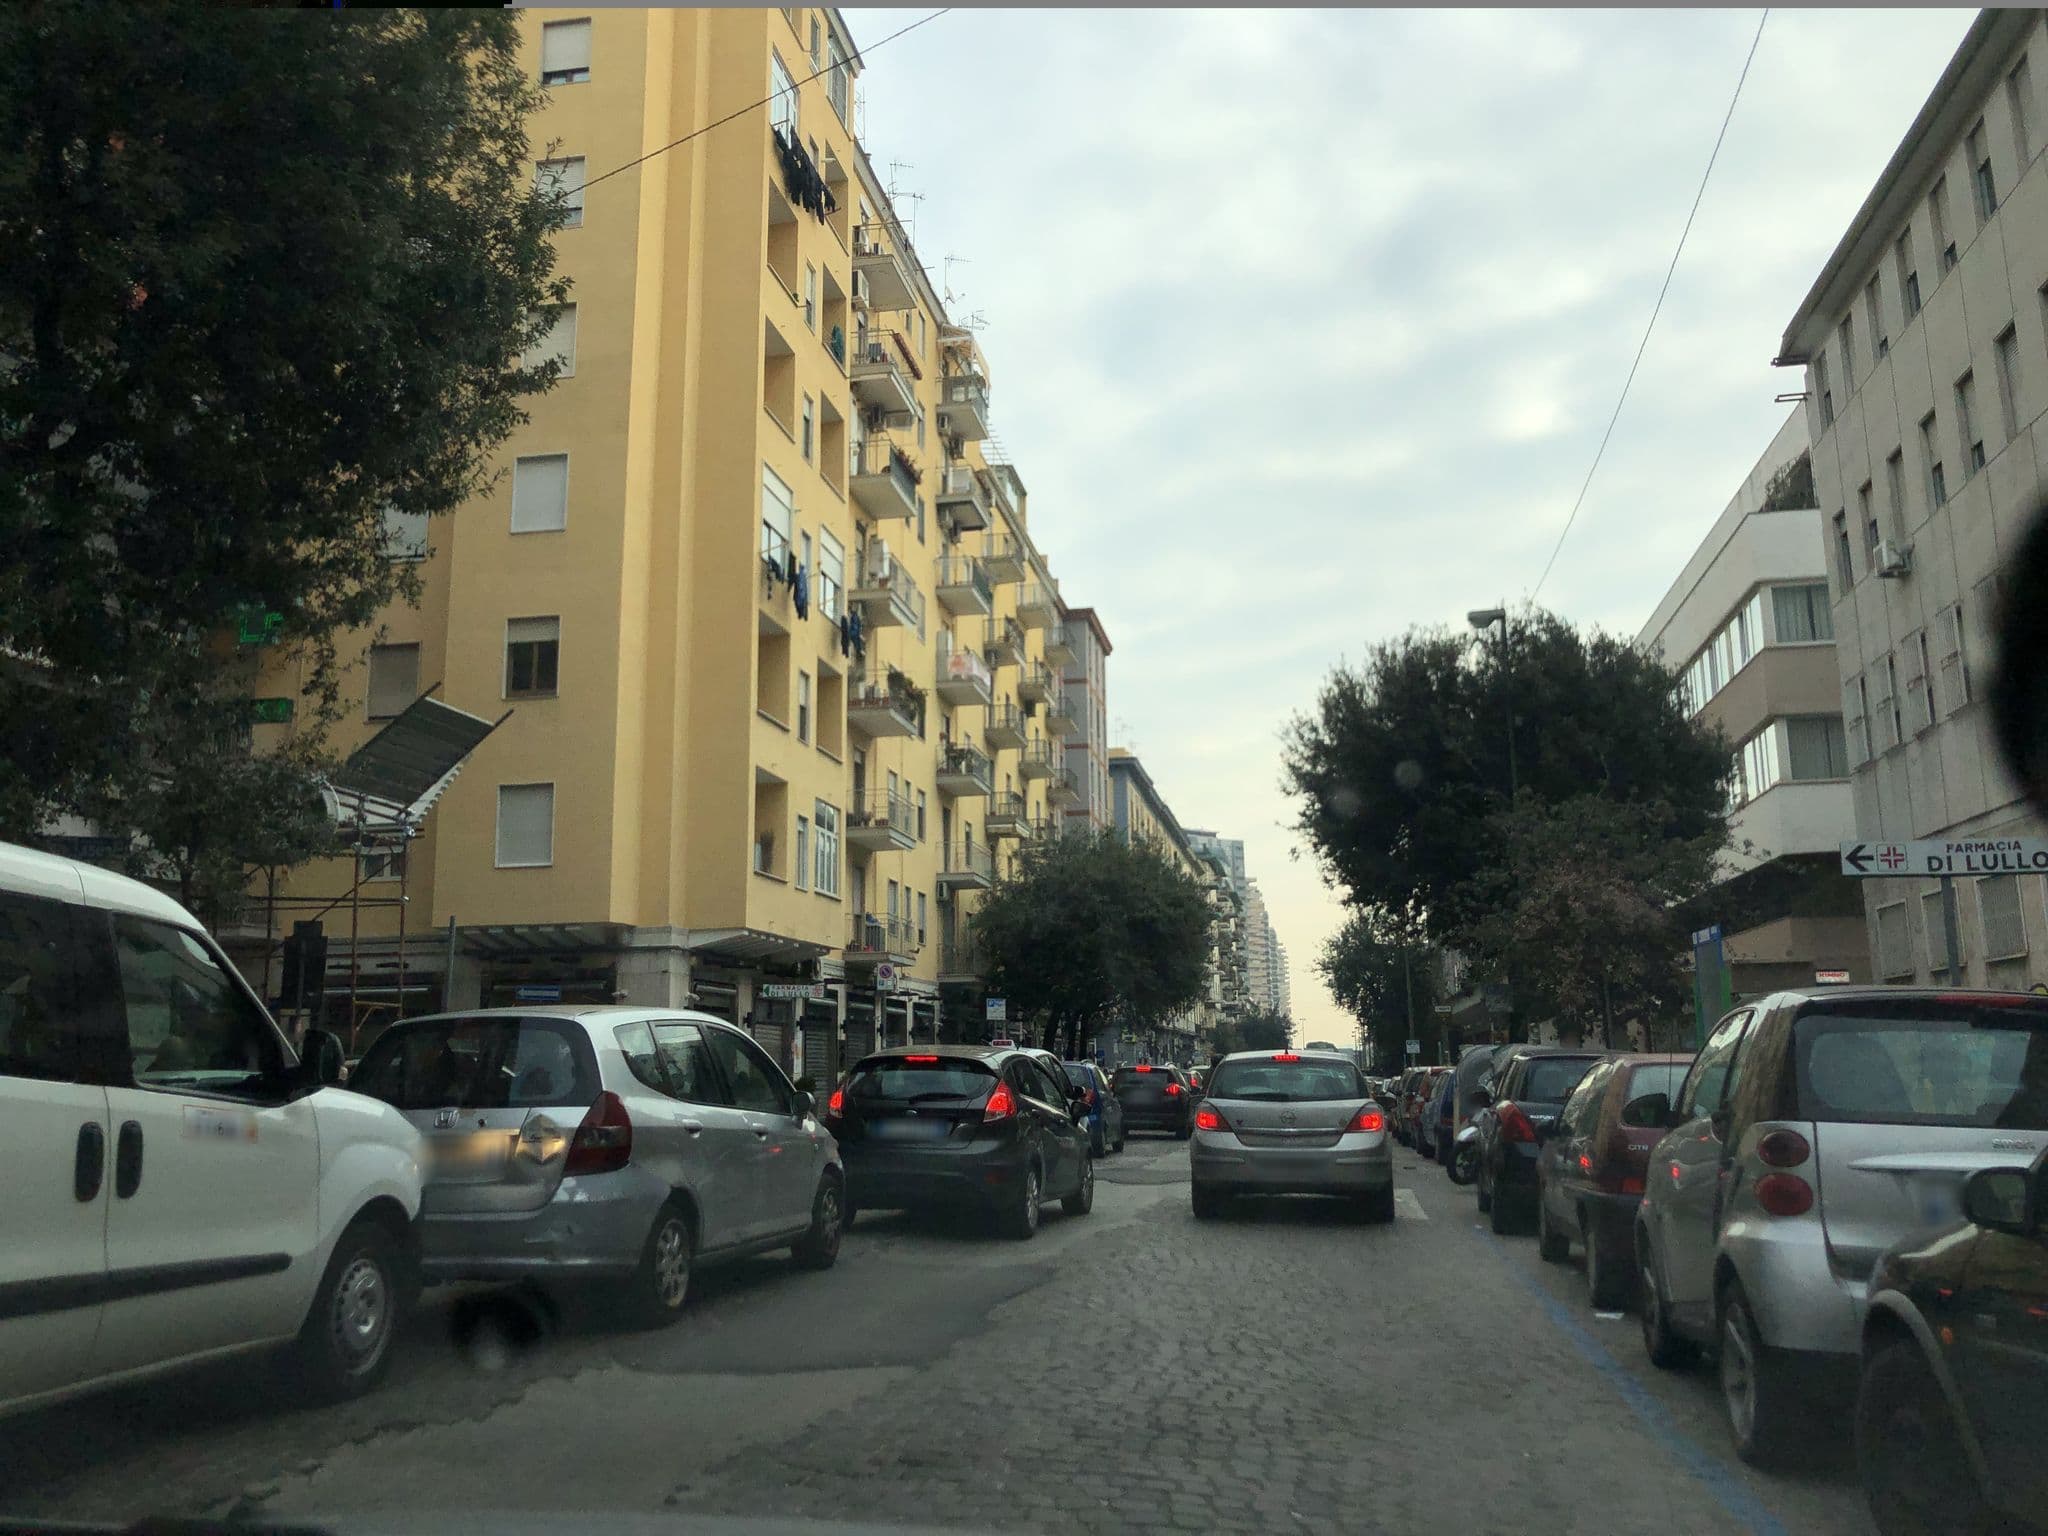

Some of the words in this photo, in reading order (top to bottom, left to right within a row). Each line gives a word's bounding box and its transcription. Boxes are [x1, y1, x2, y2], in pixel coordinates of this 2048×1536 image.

[1946, 841, 2022, 854] FARMACIA
[1927, 855, 1952, 873] DI
[1966, 851, 2048, 872] LULLO
